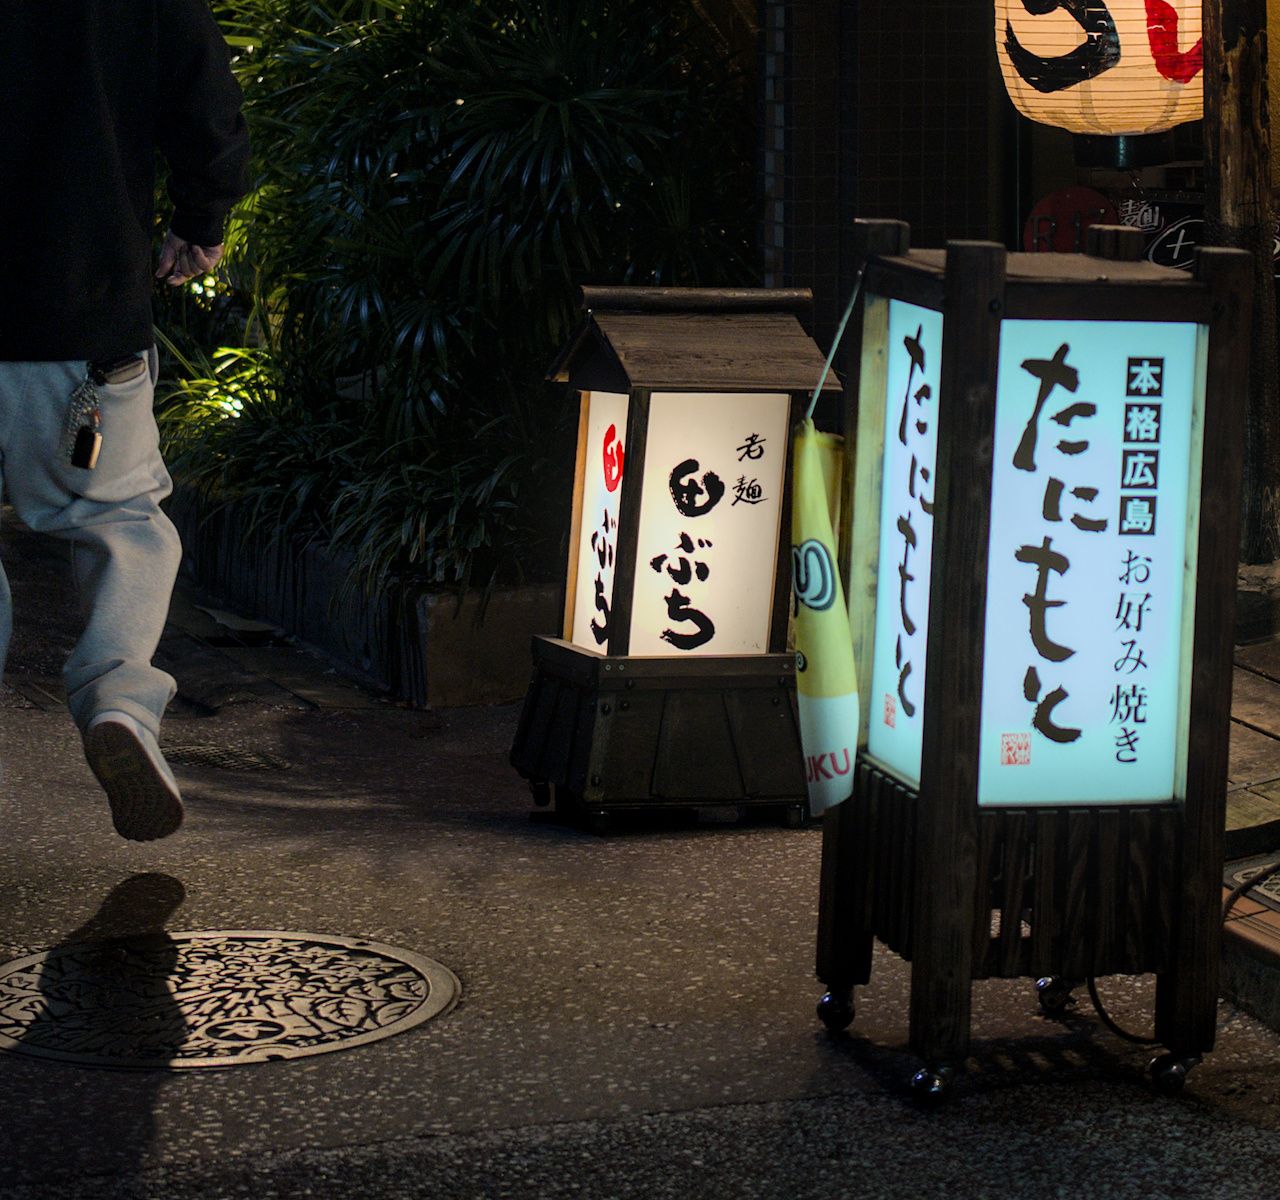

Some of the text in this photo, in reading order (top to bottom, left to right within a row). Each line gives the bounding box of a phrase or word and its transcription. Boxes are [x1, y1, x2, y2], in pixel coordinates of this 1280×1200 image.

[650, 457, 725, 651] 田ぶち
[895, 323, 934, 720] たにもと
[1012, 340, 1109, 745] たにもと
[1108, 357, 1165, 766] 本格広島 お好み焼き
